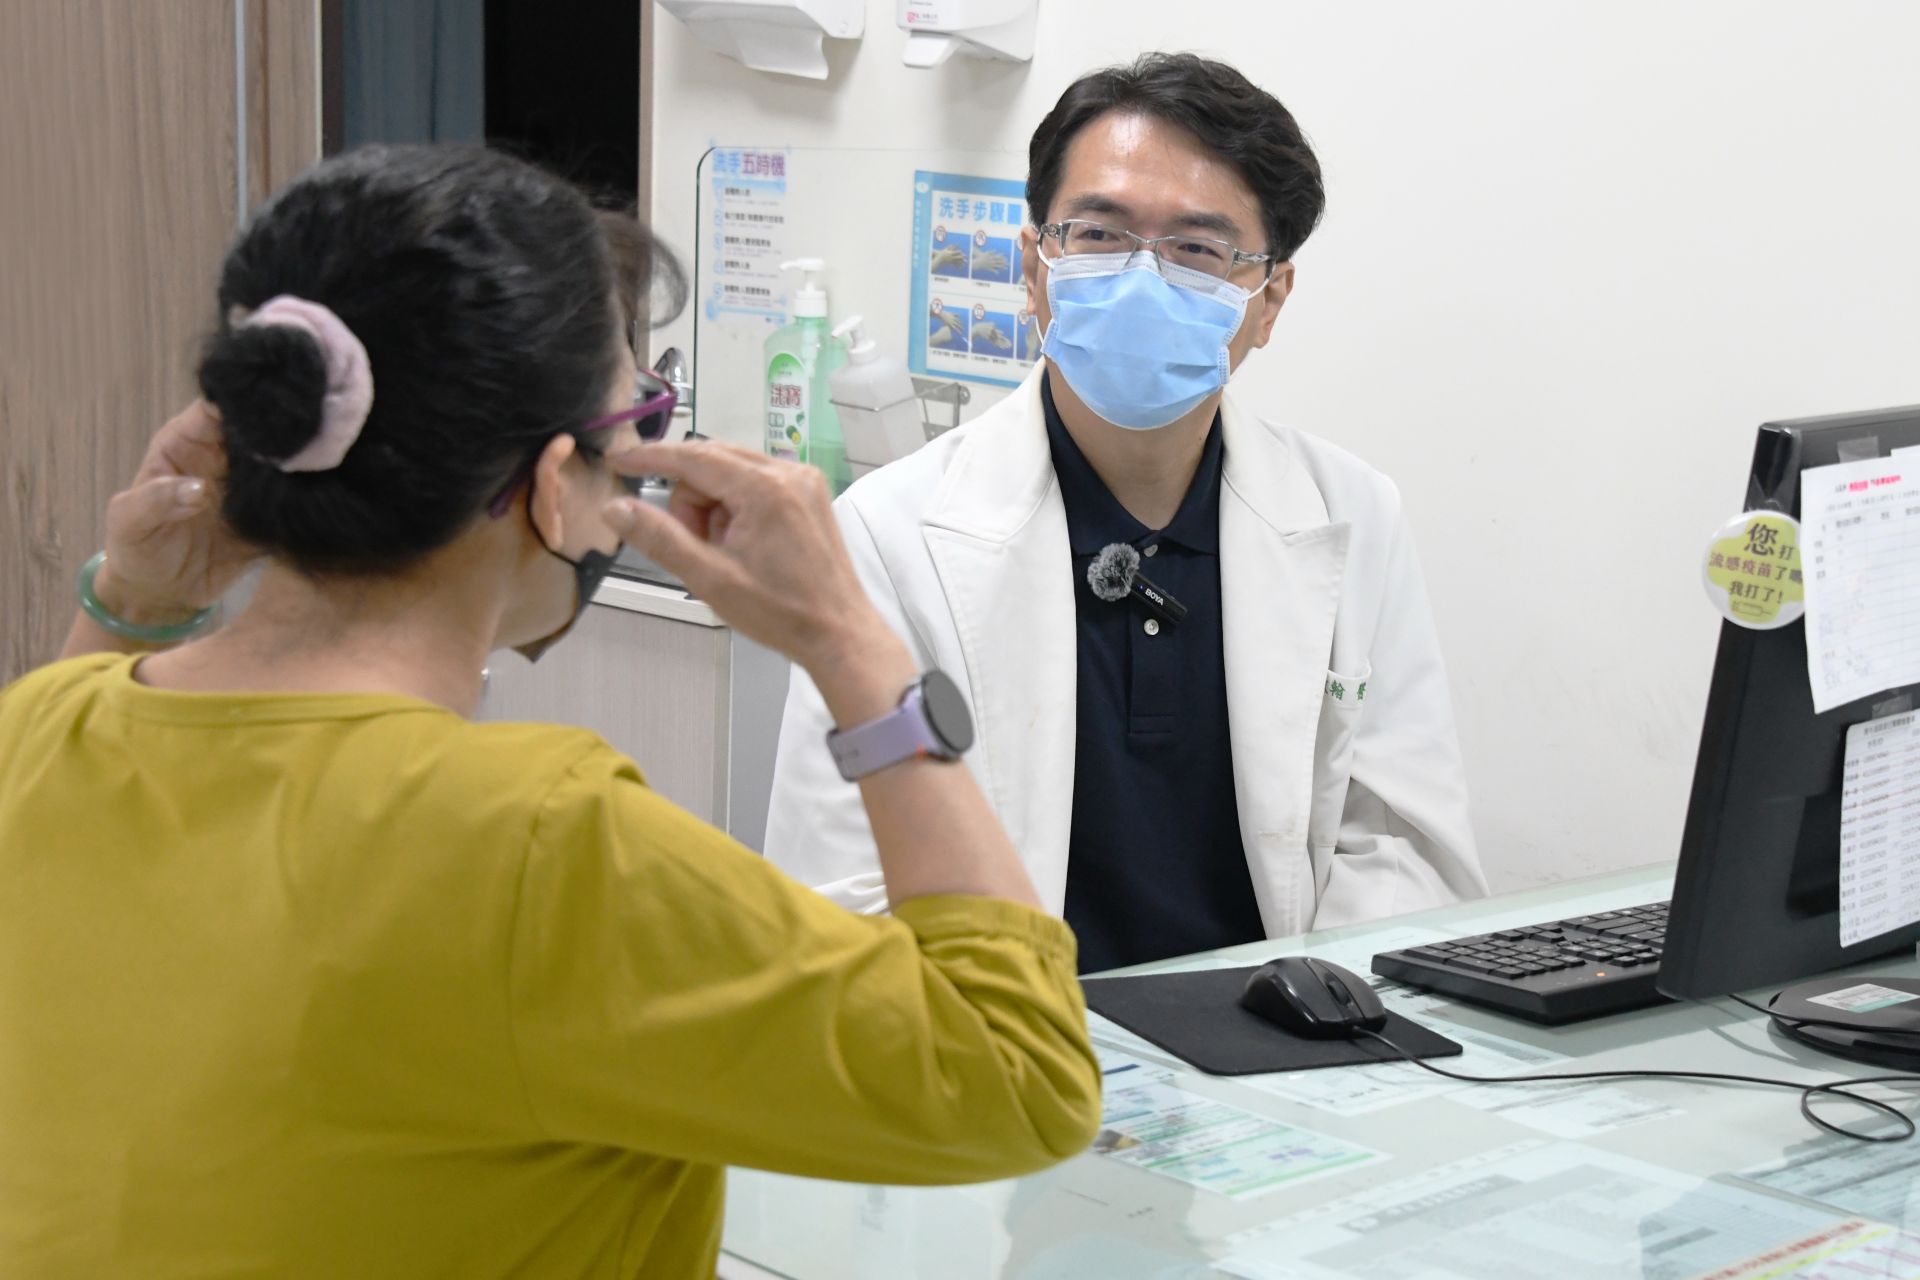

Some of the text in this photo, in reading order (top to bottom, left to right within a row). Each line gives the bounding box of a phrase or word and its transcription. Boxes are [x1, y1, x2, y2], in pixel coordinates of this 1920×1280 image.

[713, 151, 785, 176] 洗手五時機
[1145, 588, 1164, 606] BOYA
